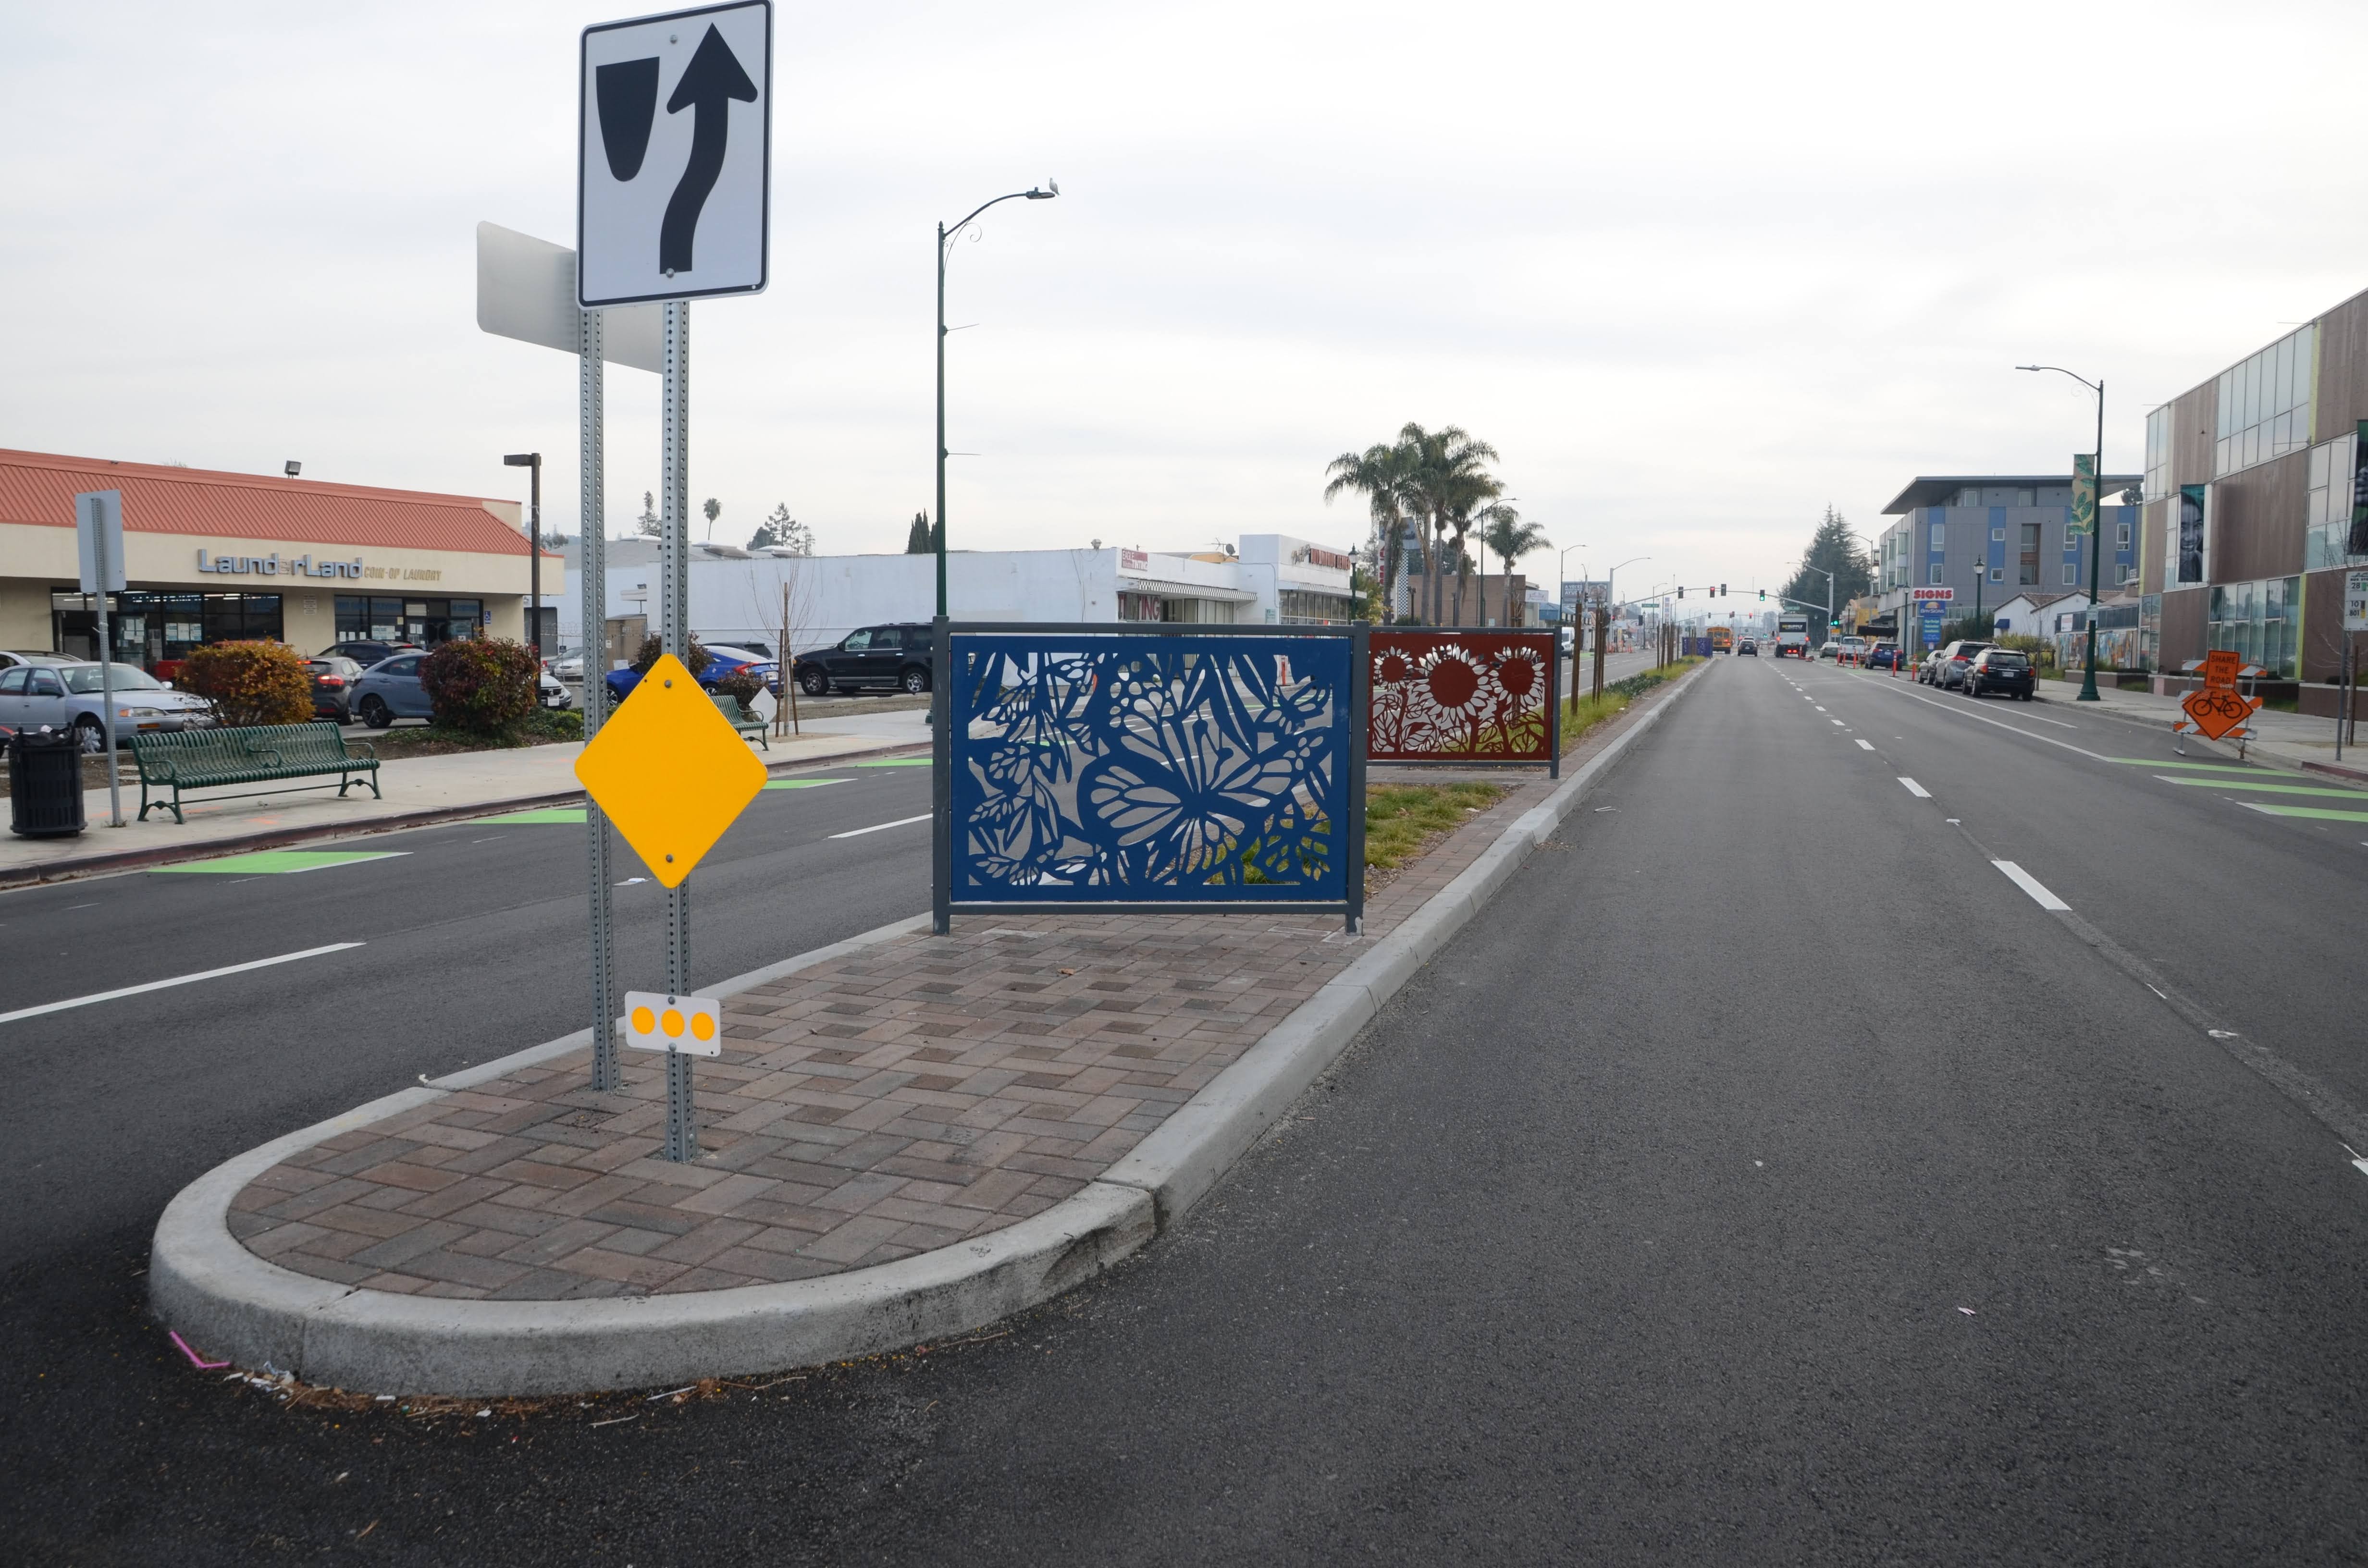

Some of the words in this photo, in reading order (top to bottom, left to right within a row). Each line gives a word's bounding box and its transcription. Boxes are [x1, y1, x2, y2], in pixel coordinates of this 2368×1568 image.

[1122, 550, 1135, 561] EAGLE
[1132, 559, 1148, 570] TINTING
[364, 566, 400, 579] COIN-OP
[403, 568, 442, 581] LAUNDRY
[1913, 590, 1952, 599] SIGNS
[2211, 655, 2236, 664] SHARE
[2216, 665, 2229, 674] THE
[2210, 676, 2231, 684] ROAD
